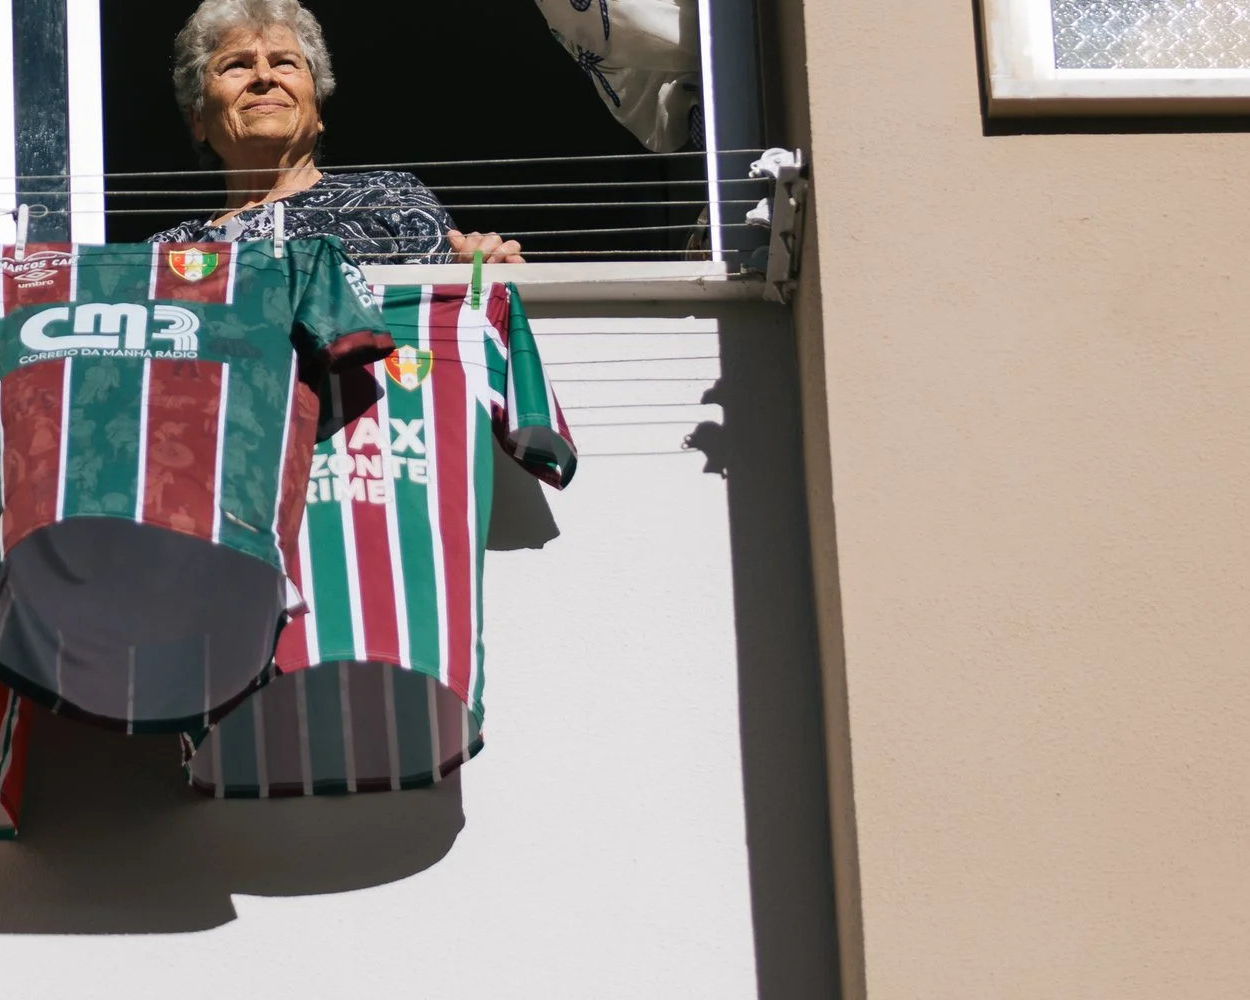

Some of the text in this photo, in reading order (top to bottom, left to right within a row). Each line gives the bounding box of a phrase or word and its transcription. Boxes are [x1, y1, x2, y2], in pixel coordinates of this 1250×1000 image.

[18, 279, 55, 289] umbro
[19, 348, 78, 365] CORREIO
[81, 348, 100, 357] DA
[310, 453, 431, 485] ZONTE
[306, 477, 393, 505] RIME
